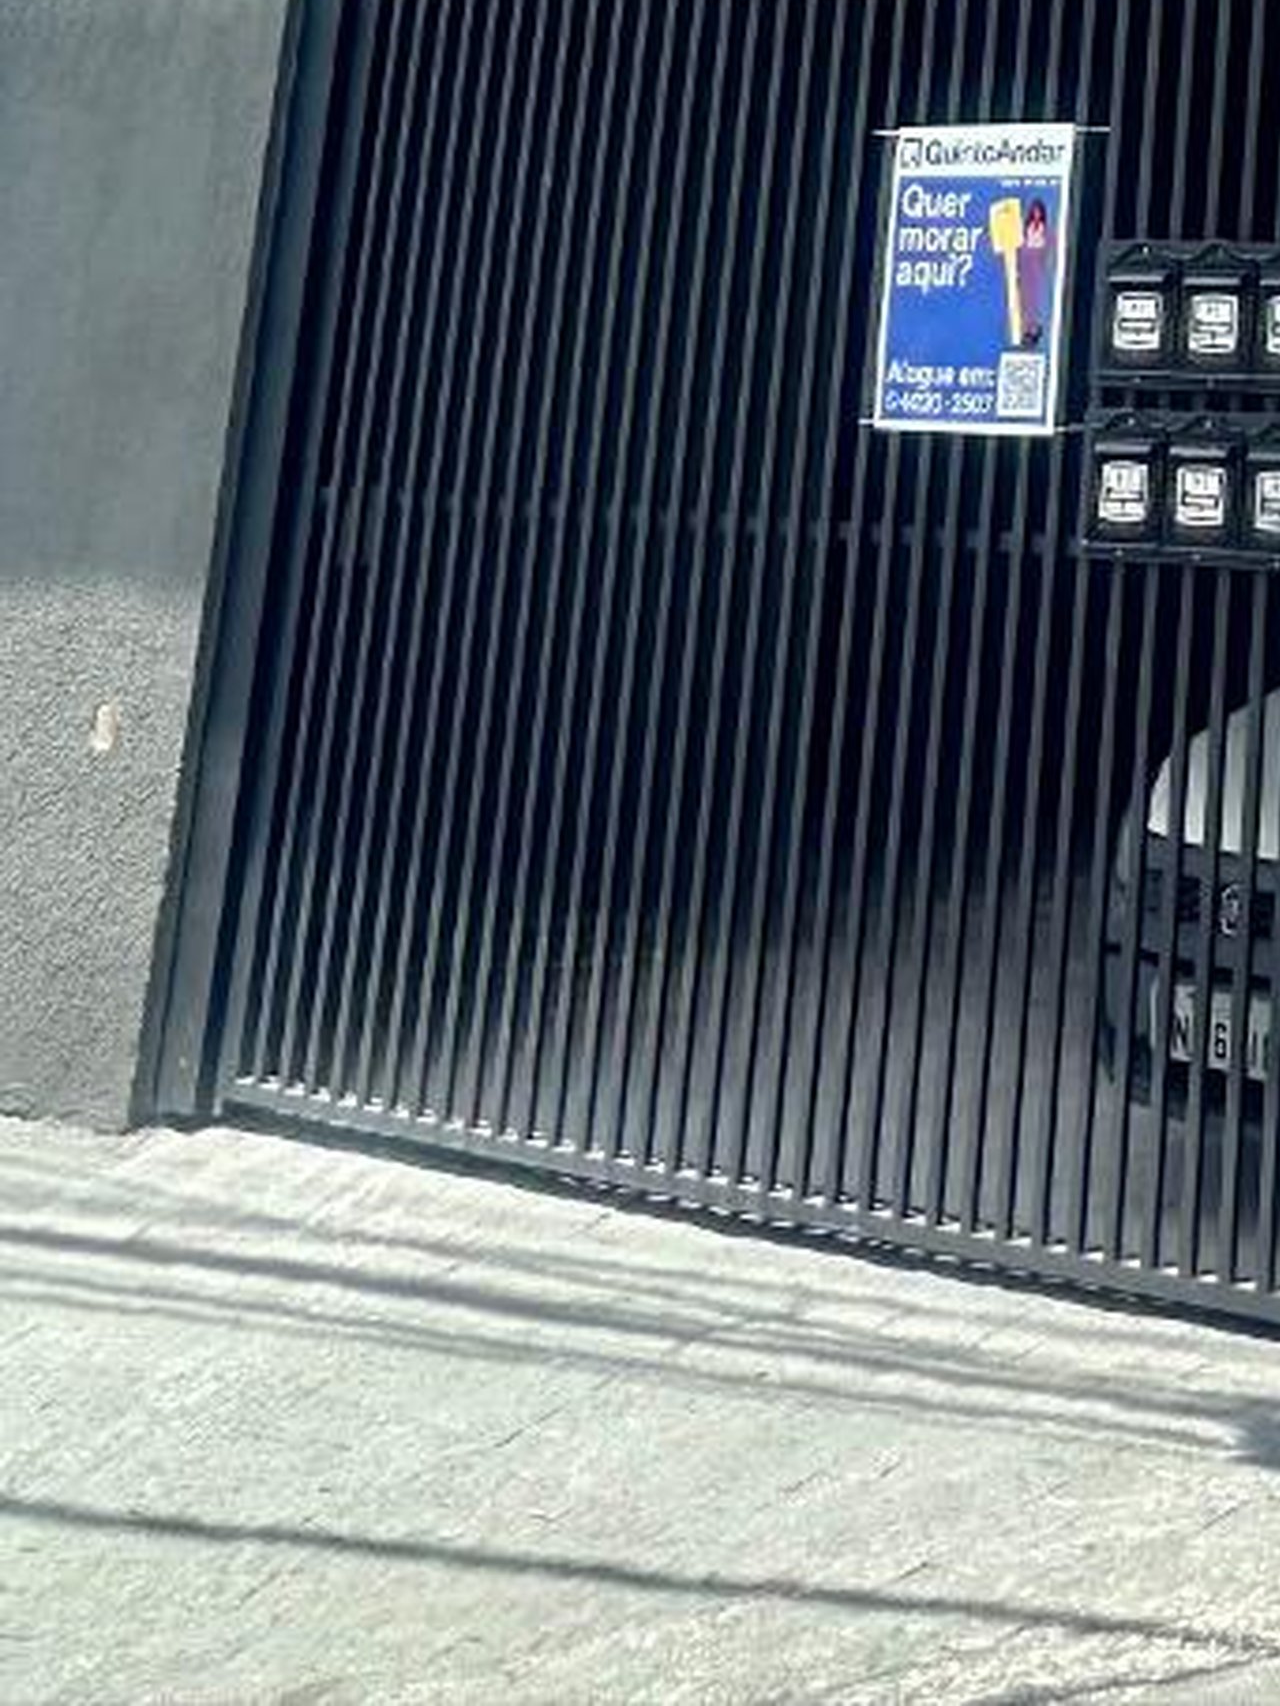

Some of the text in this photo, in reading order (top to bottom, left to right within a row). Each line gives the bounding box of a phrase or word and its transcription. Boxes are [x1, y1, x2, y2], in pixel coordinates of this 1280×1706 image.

[926, 138, 1065, 166] QuintoAndar
[901, 183, 971, 219] Quer
[899, 224, 983, 252] morar
[895, 254, 974, 294] aqui?
